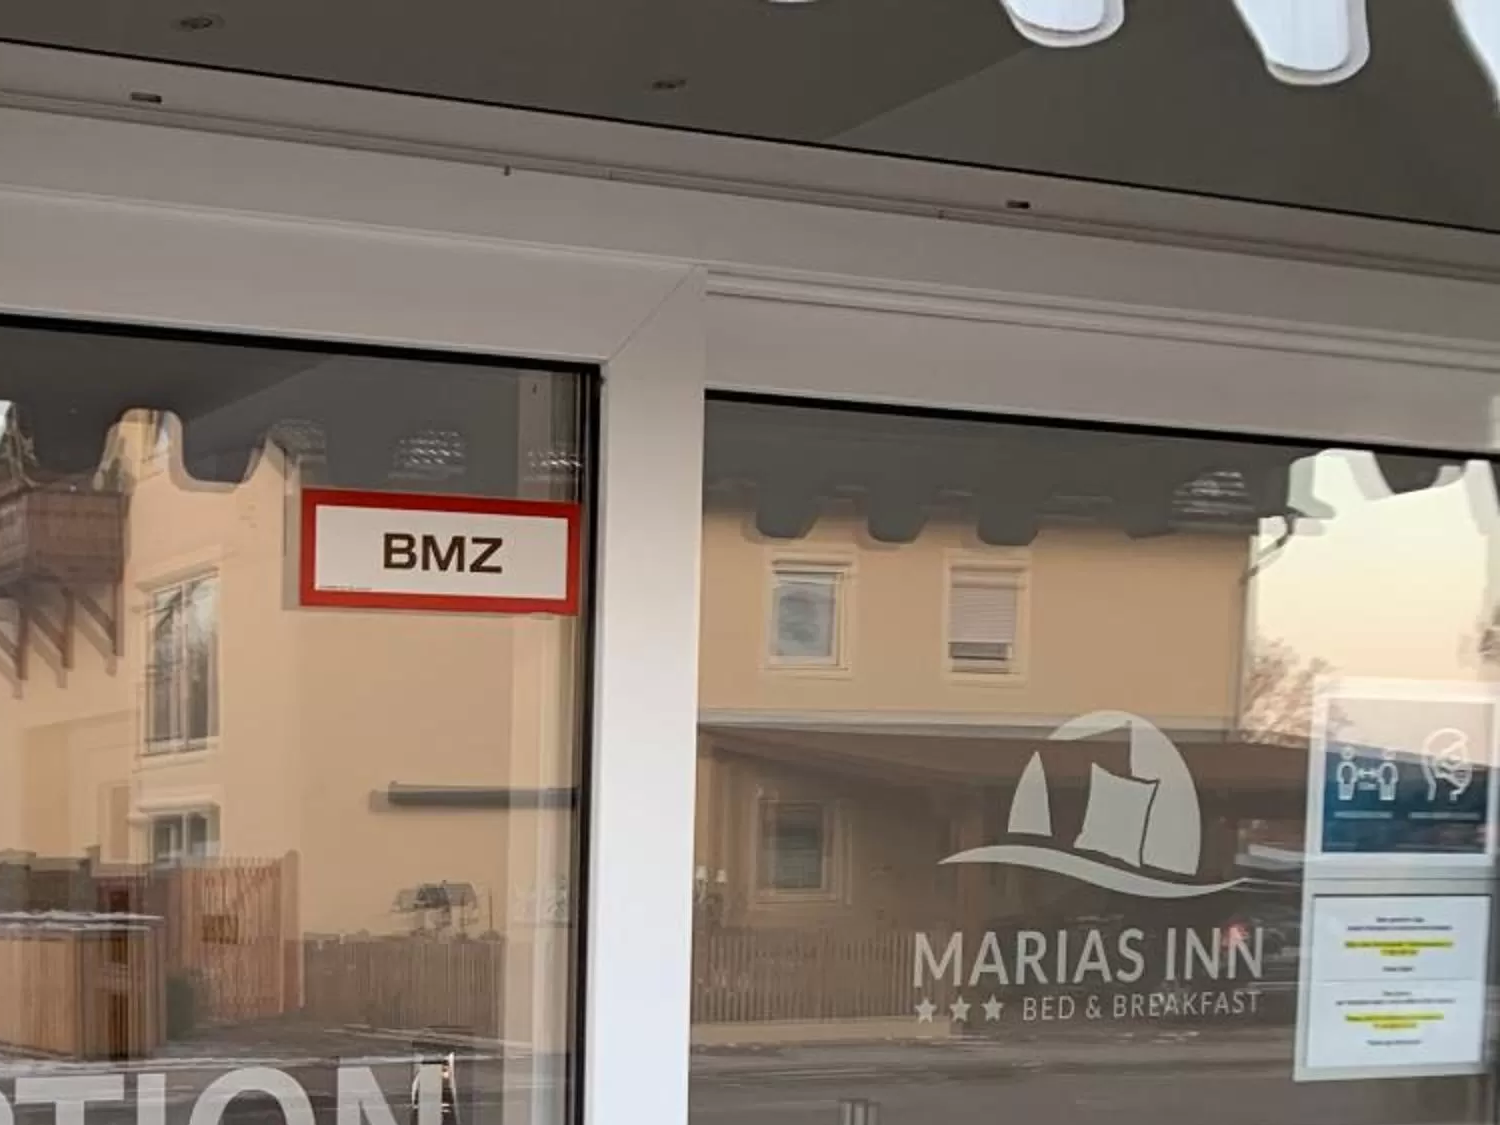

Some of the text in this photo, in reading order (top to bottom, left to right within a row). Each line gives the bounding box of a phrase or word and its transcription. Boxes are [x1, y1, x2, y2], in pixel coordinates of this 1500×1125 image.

[383, 532, 503, 574] BMZ
[913, 926, 1264, 988] MARIAS INN
[1022, 990, 1262, 1022] BED & BREAKFAST
